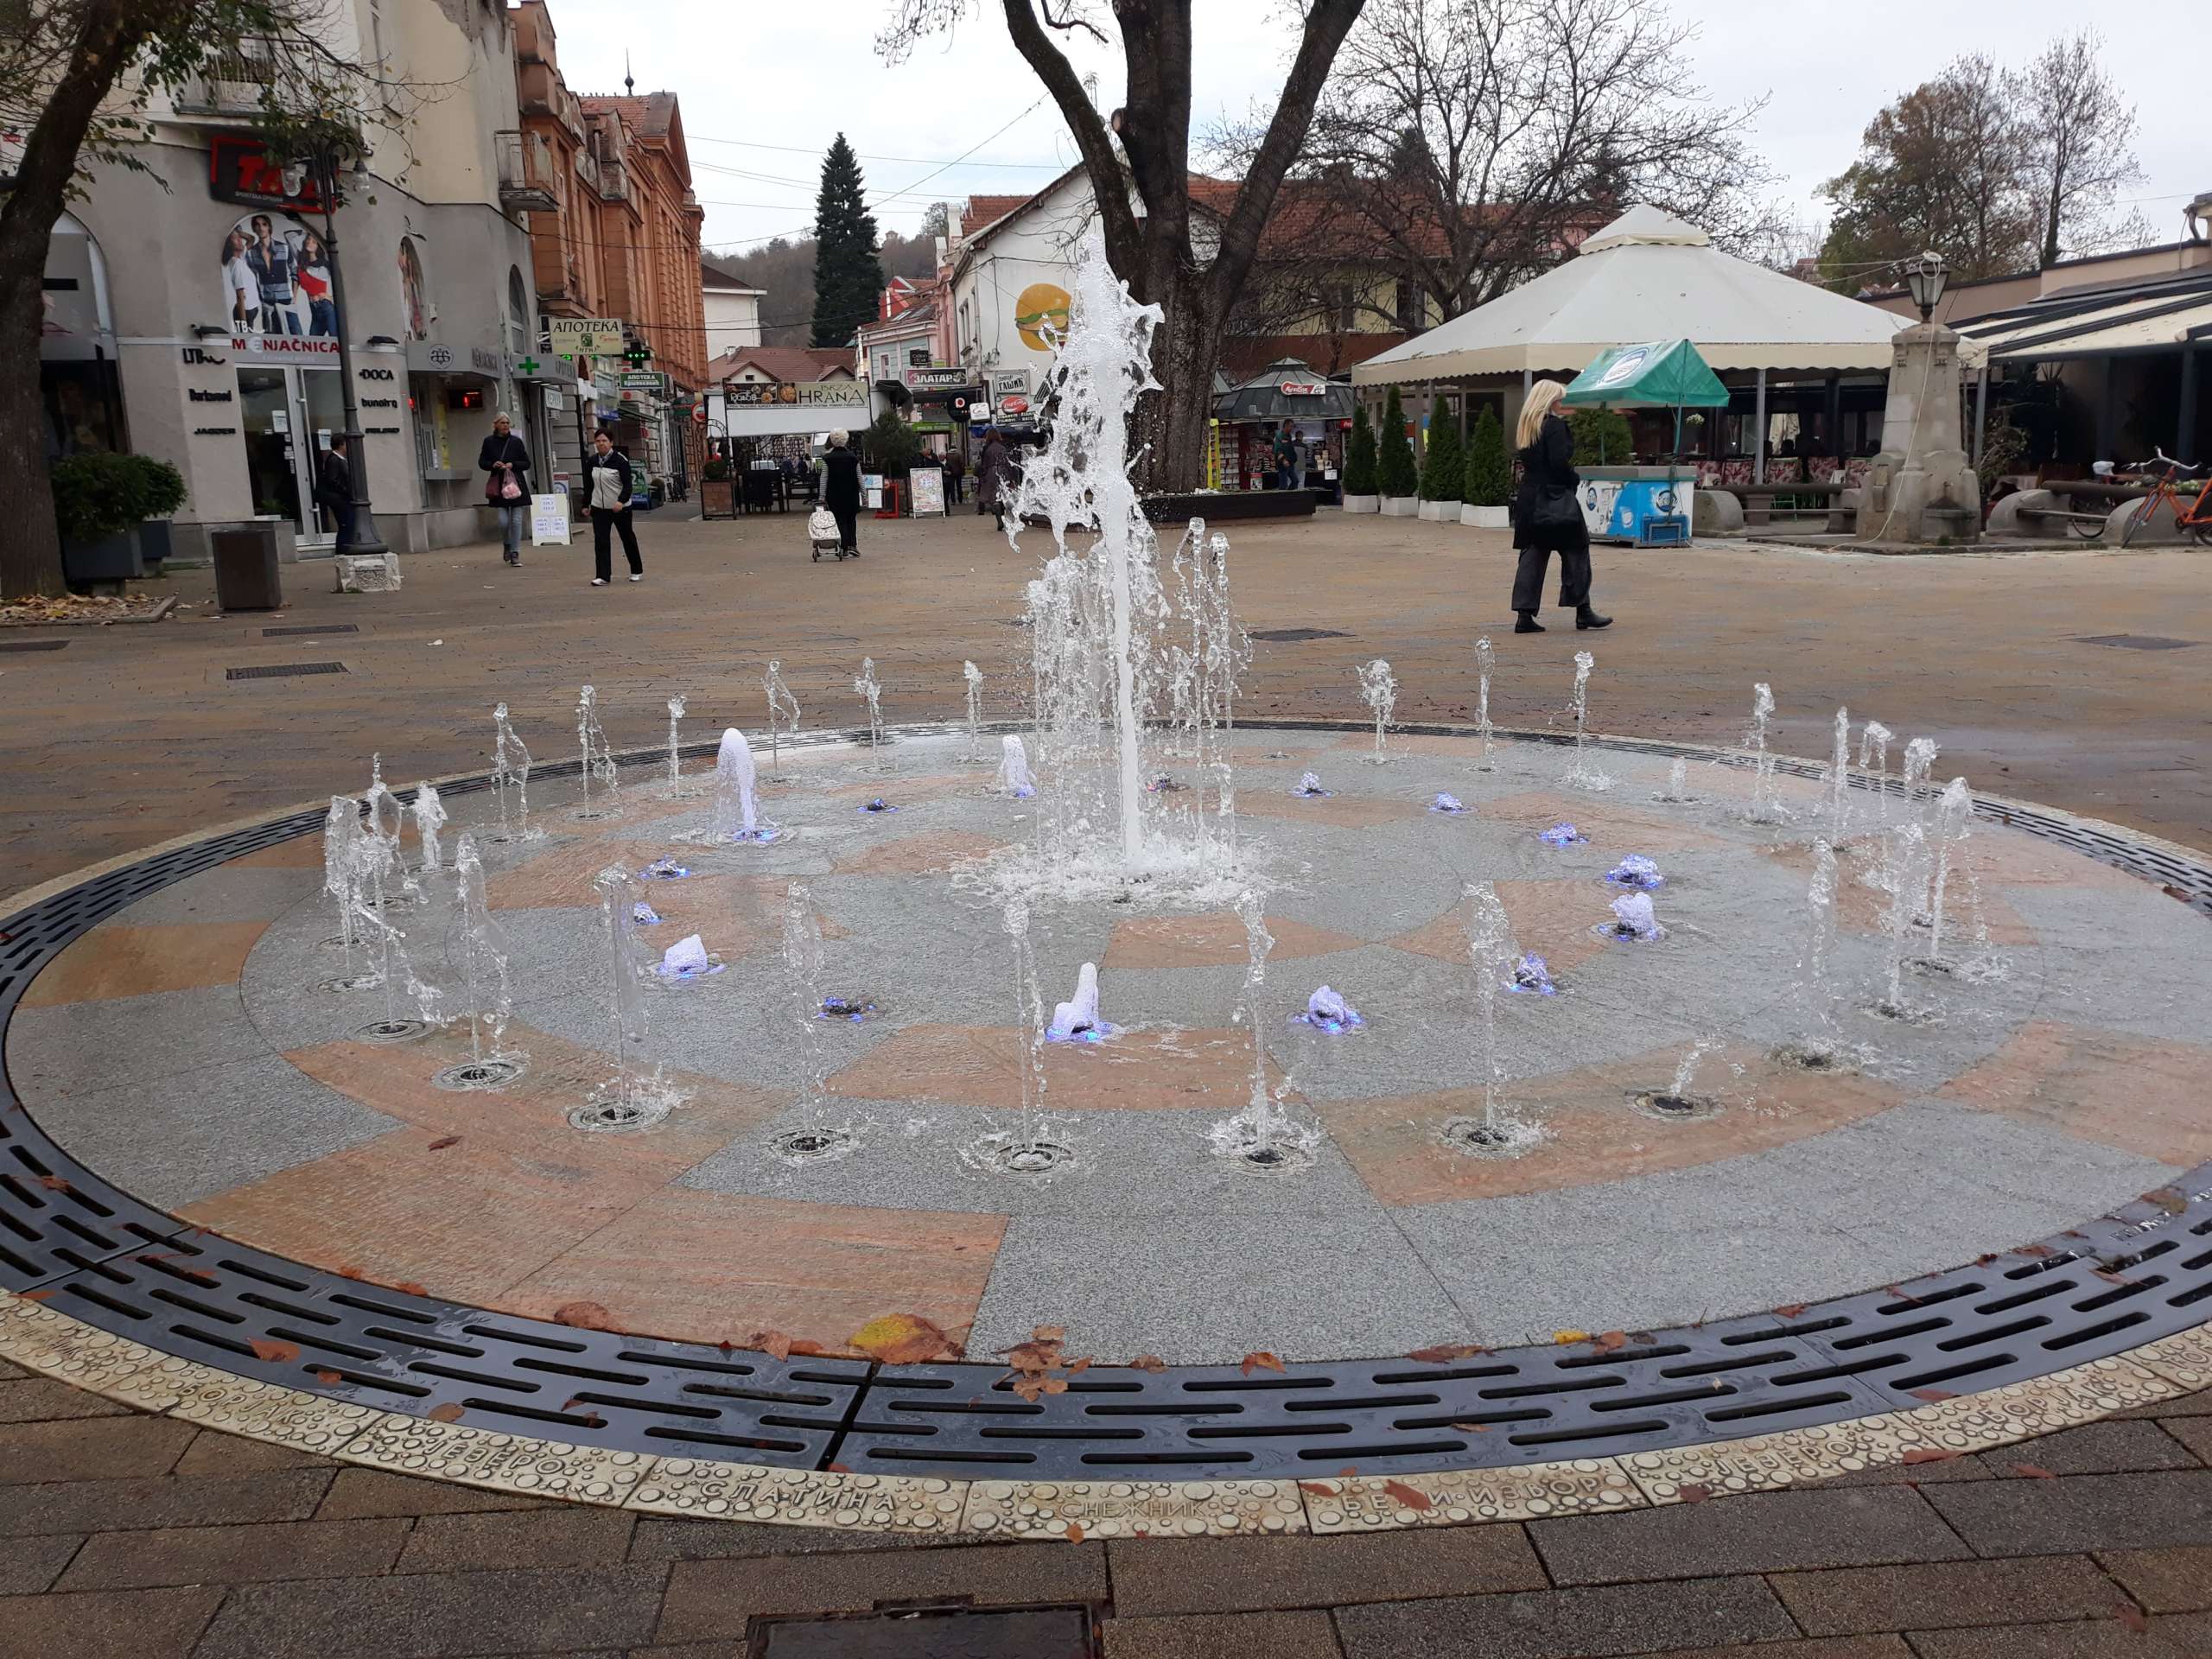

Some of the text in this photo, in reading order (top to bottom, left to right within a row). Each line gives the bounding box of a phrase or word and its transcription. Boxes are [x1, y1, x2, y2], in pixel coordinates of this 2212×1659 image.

[553, 321, 619, 333] АПОТЕКА
[912, 373, 953, 384] ЗЛАТАР
[798, 390, 865, 404] HRANA
[701, 1480, 896, 1511] СЛАТИНА
[1341, 1489, 1453, 1511] БЕИ
[1060, 1500, 1205, 1518] СНЕЖНИК
